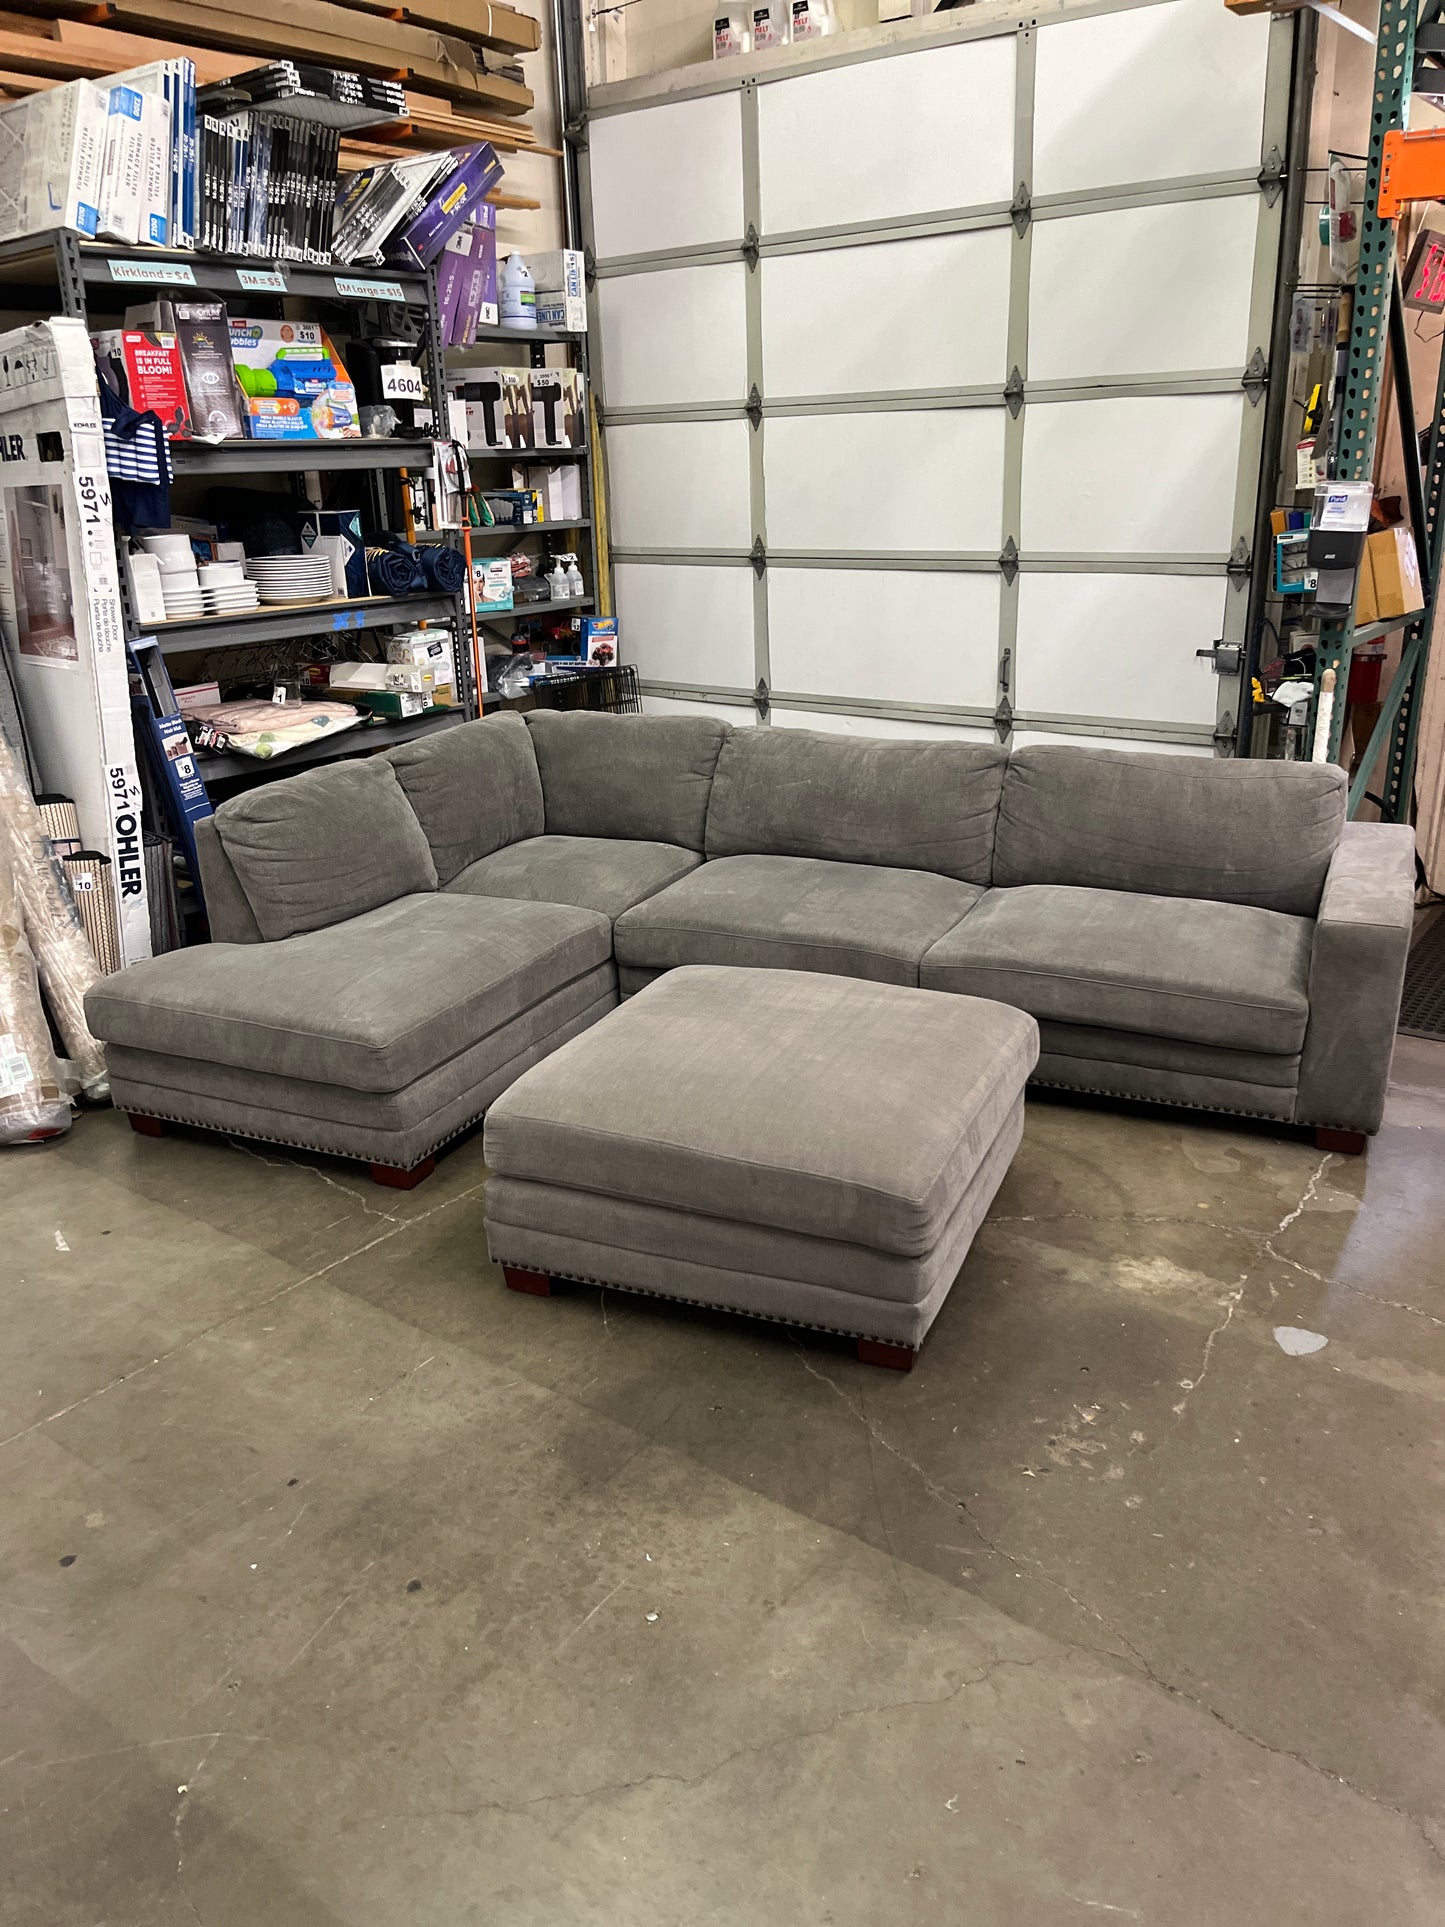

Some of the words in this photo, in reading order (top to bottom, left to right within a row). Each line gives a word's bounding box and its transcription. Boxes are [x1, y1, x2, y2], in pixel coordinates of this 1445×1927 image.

[133, 97, 142, 116] 2200
[134, 133, 142, 168] FURNACE
[456, 236, 463, 249] 3M
[113, 267, 164, 279] Kirkland
[176, 271, 190, 280] $4
[242, 275, 257, 284] 3M
[268, 276, 281, 287] $5
[337, 283, 351, 292] 3M
[353, 285, 379, 296] Large
[387, 288, 403, 297] $15
[486, 306, 490, 320] 3M
[300, 332, 314, 340] $10
[138, 366, 172, 374] BLOOM!
[387, 378, 421, 394] 4604
[79, 476, 101, 523] 5971
[110, 768, 130, 810] 5971
[116, 812, 142, 899] OHLER
